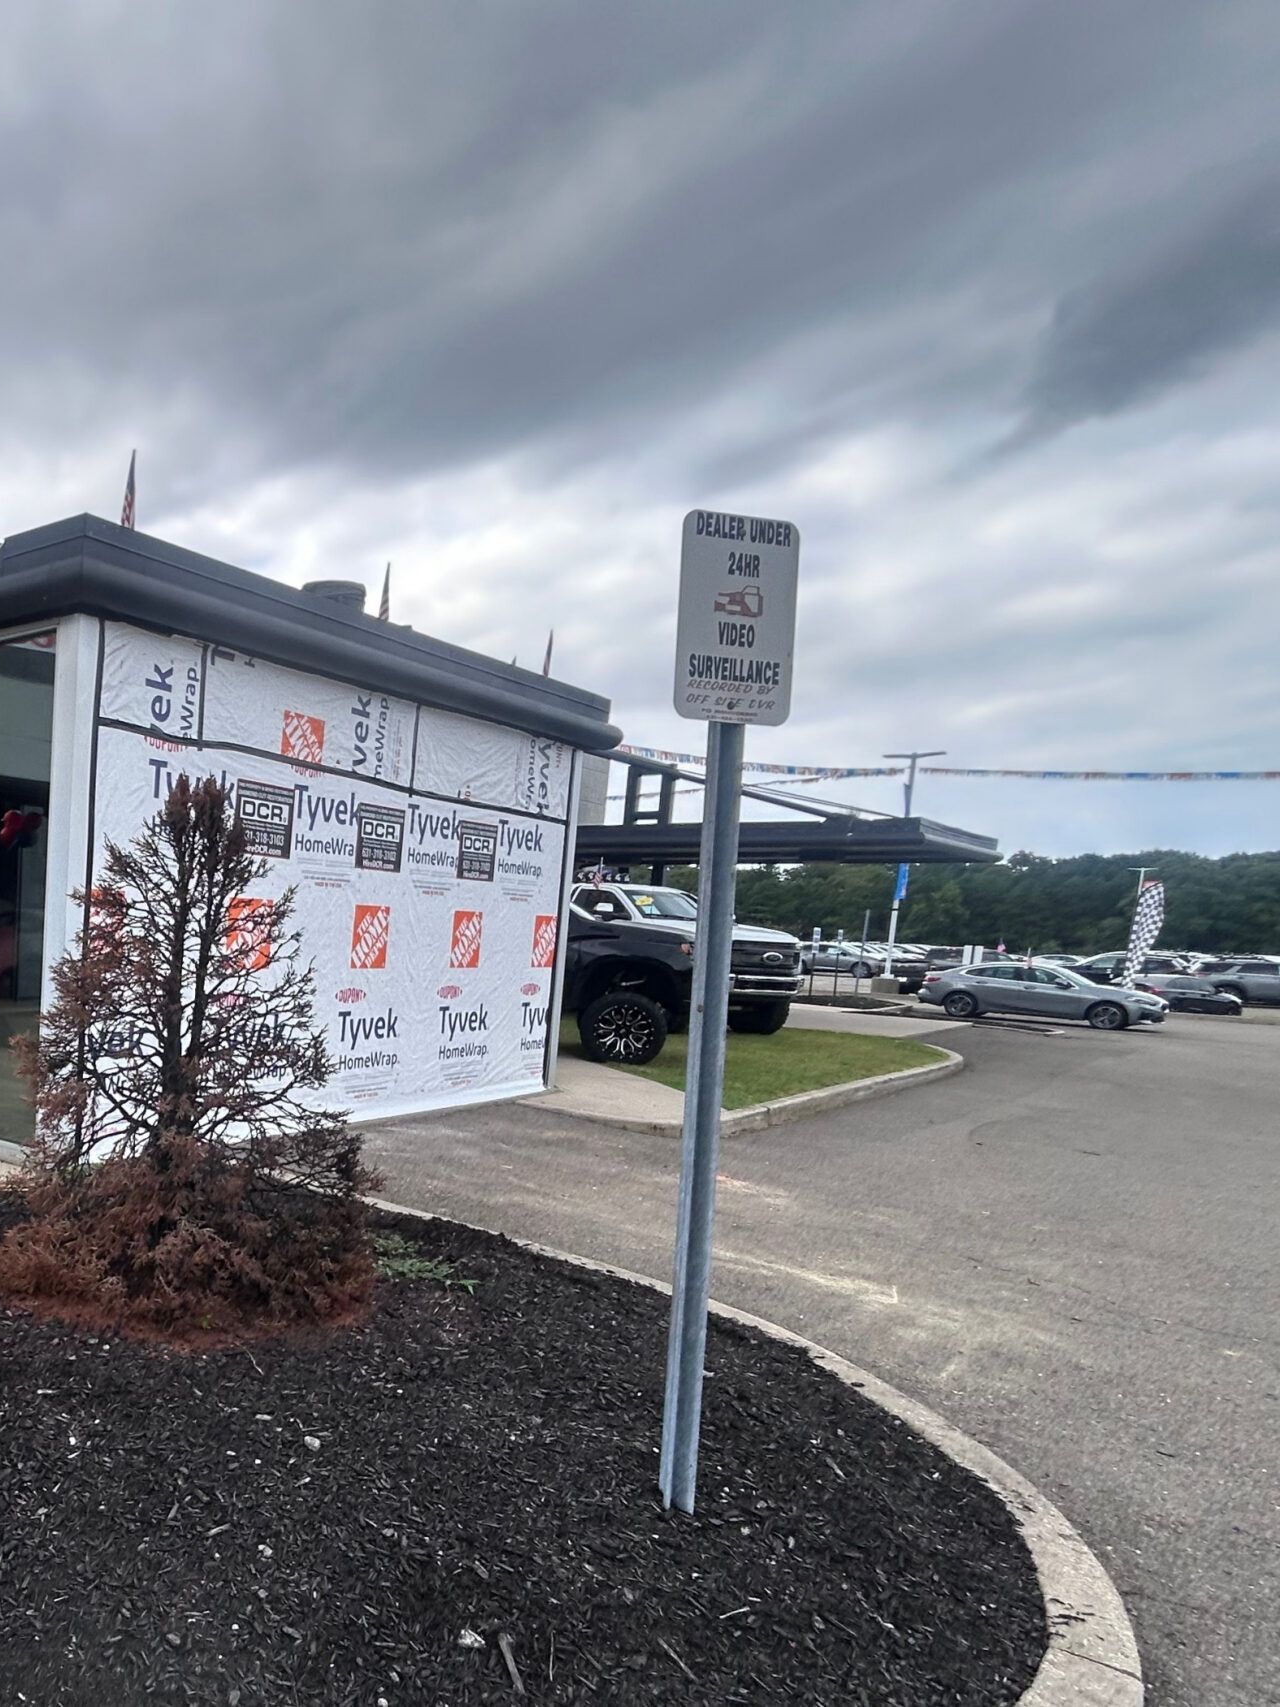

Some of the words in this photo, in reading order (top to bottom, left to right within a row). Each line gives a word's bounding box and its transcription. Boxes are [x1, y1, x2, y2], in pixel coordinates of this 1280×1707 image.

[696, 511, 746, 541] DEALER
[750, 519, 792, 547] UNDER
[728, 552, 760, 578] 24HR
[718, 621, 755, 648] VIDEO
[688, 653, 780, 685] SURVEILLANCE
[686, 679, 753, 694] RECORDED
[757, 685, 775, 695] BY
[686, 693, 711, 704] OFF
[242, 799, 283, 822] DCR
[294, 784, 359, 831] Tyvek
[363, 821, 395, 839] DCR
[407, 803, 460, 845] Tyvek
[244, 830, 284, 847] 31-318-3103
[295, 833, 355, 856] HomeWra
[464, 836, 490, 853] DCR
[498, 819, 543, 856] Tyvek
[497, 858, 542, 879] HomeWrap
[352, 905, 389, 968] HOME
[451, 911, 481, 968] HOME
[338, 1008, 398, 1050] Tyvek
[439, 1003, 488, 1041] Tyvek
[339, 1051, 398, 1071] HomeWrap
[438, 1042, 487, 1060] HomeWrap
